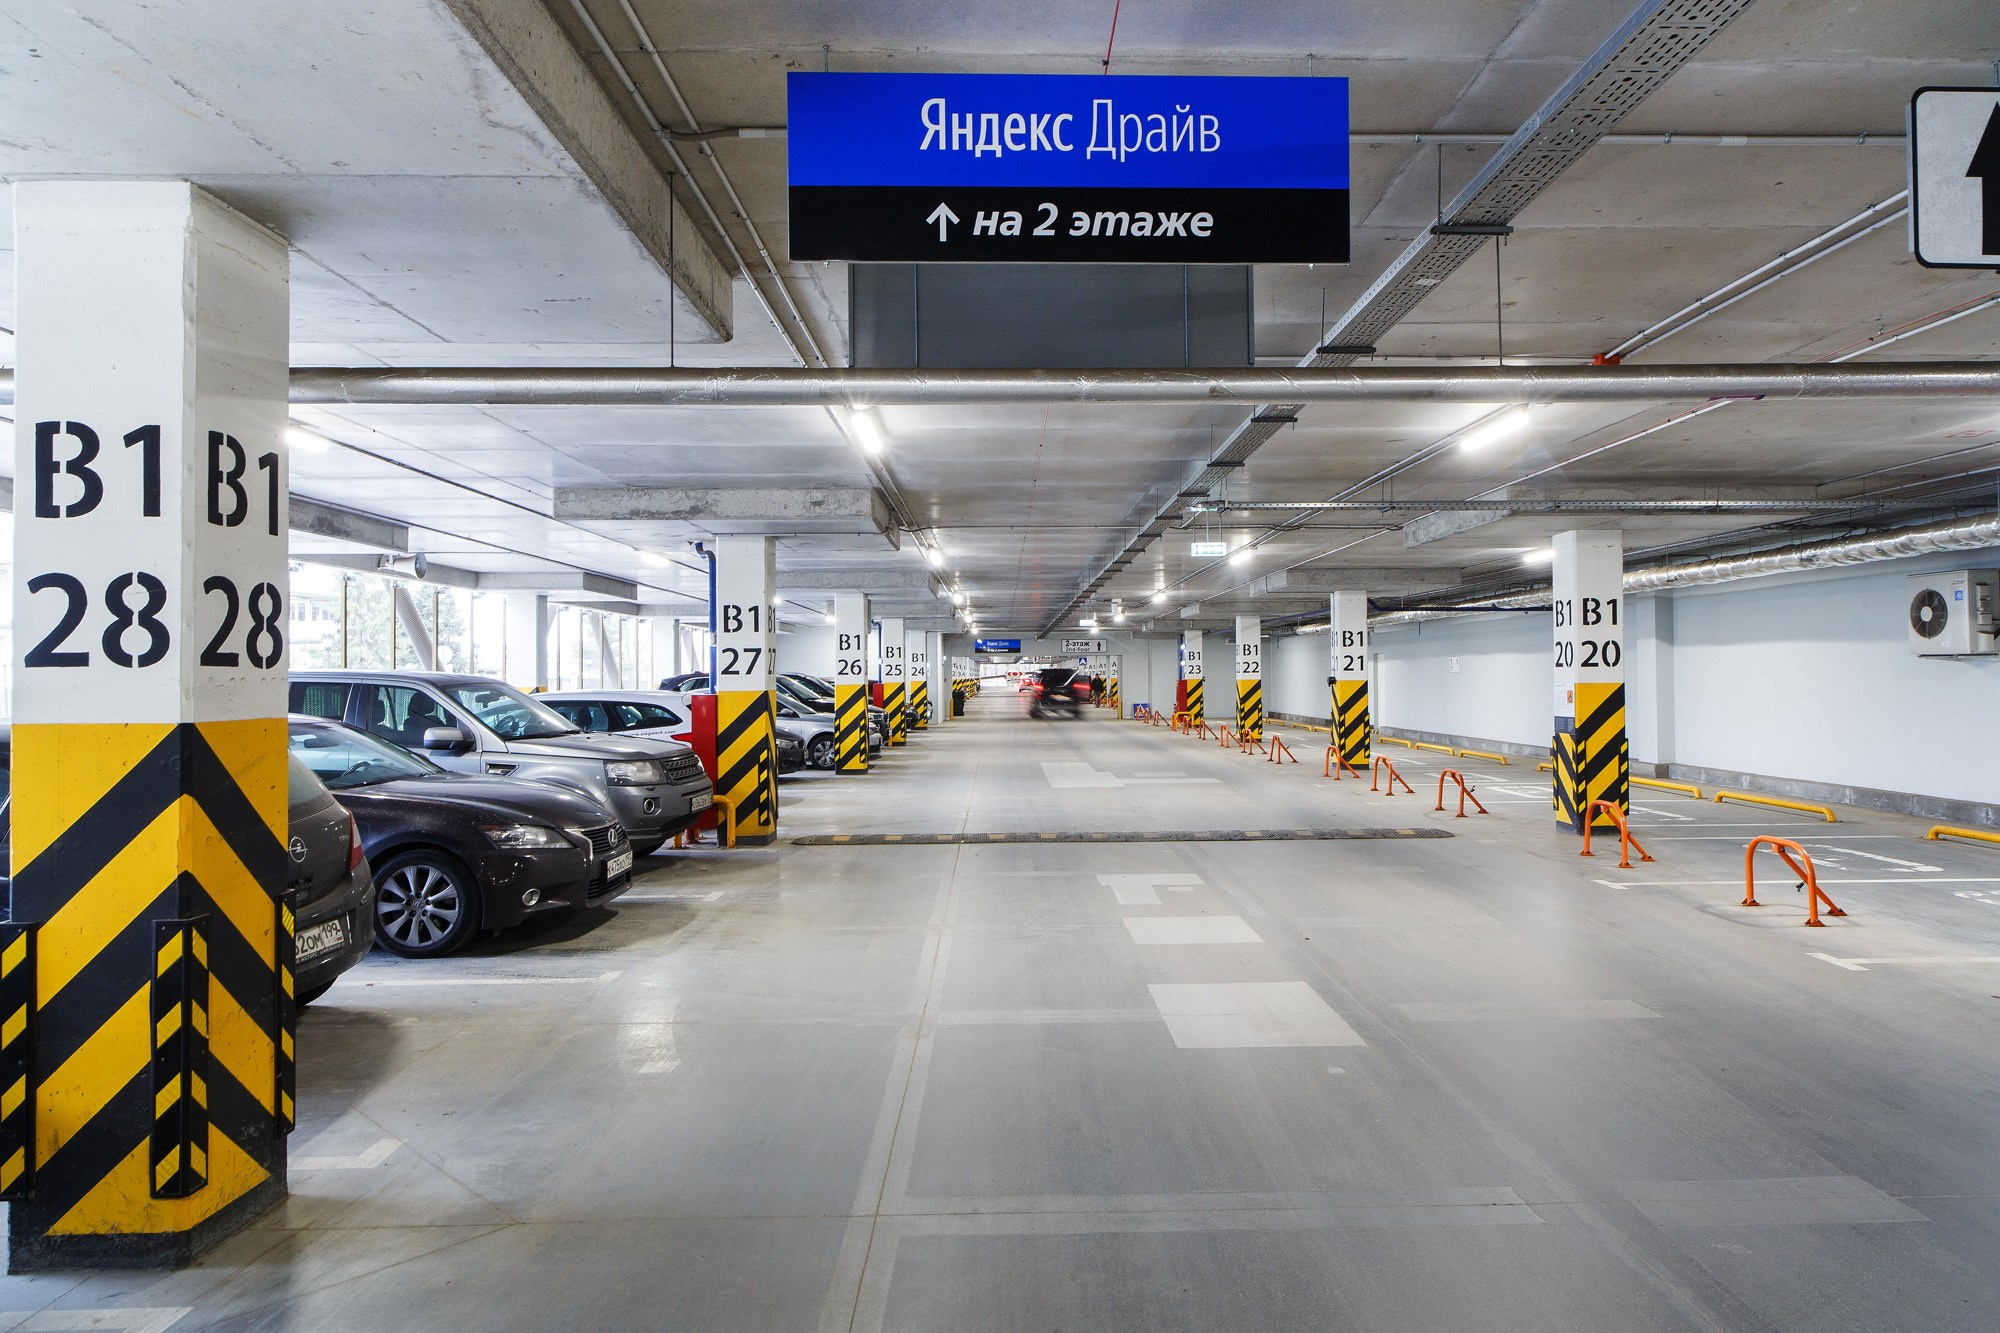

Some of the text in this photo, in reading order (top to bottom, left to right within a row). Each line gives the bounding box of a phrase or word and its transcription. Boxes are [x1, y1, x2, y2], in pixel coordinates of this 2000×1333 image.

[920, 97, 1221, 162] Яндекс Драйв
[972, 202, 1214, 237] на 2 этаже
[35, 420, 161, 518] B1
[207, 430, 279, 536] B1
[24, 571, 171, 668] 28
[200, 575, 283, 669] 28
[723, 604, 760, 633] B1
[1555, 599, 1572, 627] B1
[1582, 597, 1618, 626] B1
[839, 633, 861, 651] B1
[1242, 643, 1259, 656] B1
[1342, 630, 1364, 647] B1
[720, 647, 762, 675] 27
[886, 646, 902, 659] B1
[911, 652, 924, 662] B1
[1188, 651, 1201, 661] B1
[1343, 655, 1364, 672] 21
[1555, 640, 1574, 668] 20
[1580, 639, 1621, 668] 20
[837, 658, 863, 676] 26
[885, 664, 902, 676] 25
[911, 667, 925, 677] 24
[1188, 664, 1202, 675] 23
[1242, 661, 1259, 673] 22
